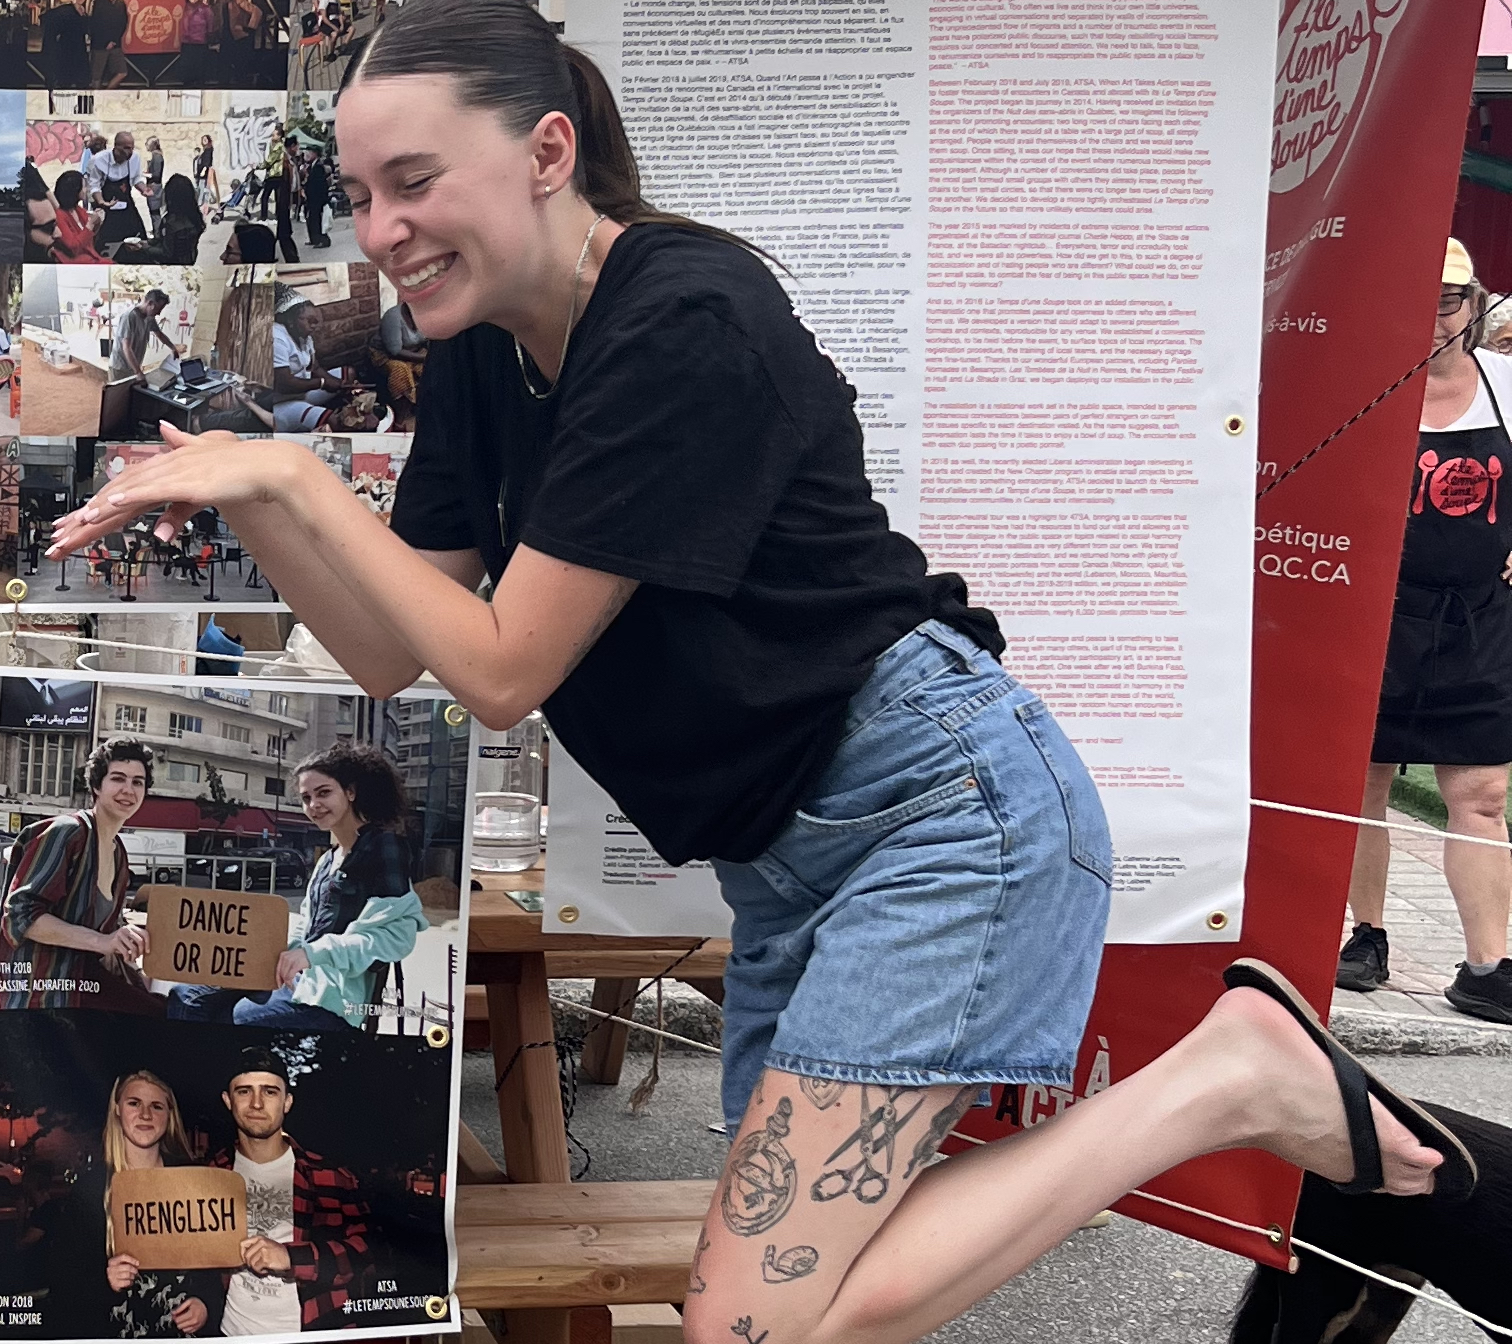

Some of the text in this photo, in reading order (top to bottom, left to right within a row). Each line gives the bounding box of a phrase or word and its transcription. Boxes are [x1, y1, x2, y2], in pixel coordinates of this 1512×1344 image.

[1254, 523, 1351, 554] oétique
[178, 898, 250, 936] DANCE
[13, 962, 32, 974] 2018
[173, 941, 247, 977] OR DIE
[33, 979, 76, 991] ACHRAFIEH
[79, 980, 100, 993] 2020
[995, 1083, 1087, 1128] ACT
[124, 1197, 236, 1235] FRENGLISH
[377, 1280, 397, 1293] ATSA
[12, 1295, 33, 1308] 2018
[343, 1295, 433, 1314] #LETEMPSDUNESOU
[9, 1312, 42, 1325] INSPIRE
